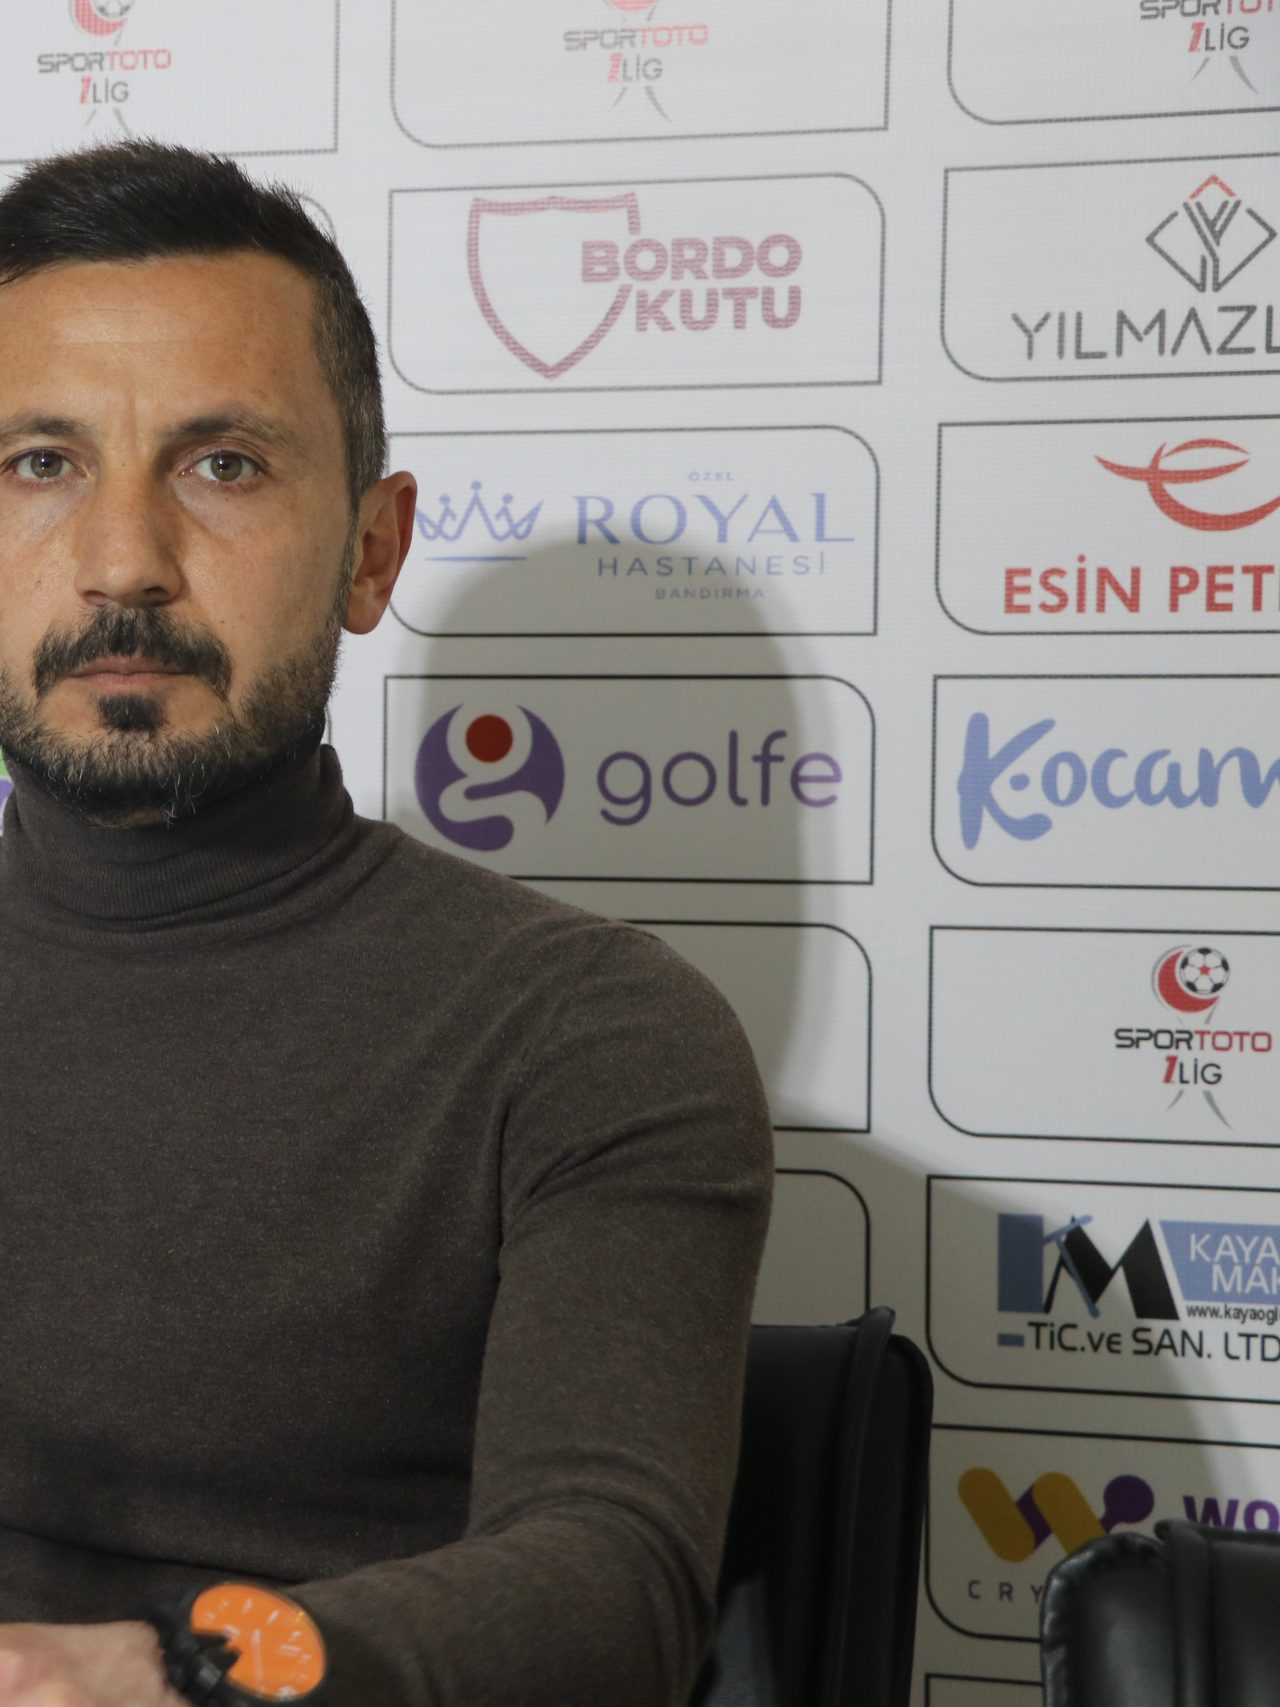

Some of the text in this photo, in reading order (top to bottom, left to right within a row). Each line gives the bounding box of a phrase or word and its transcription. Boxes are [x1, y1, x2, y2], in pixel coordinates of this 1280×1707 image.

[563, 23, 709, 51] SPORTOTO
[37, 48, 173, 74] SPORTOTO
[581, 234, 802, 283] BORDO
[635, 286, 802, 332] KUTU
[573, 492, 856, 545] ROYAL
[598, 551, 825, 577] HASTANESİ
[655, 586, 766, 600] BANDIRMA
[1004, 554, 1280, 614] ESİN PET
[597, 730, 843, 826] golfe
[1115, 1028, 1272, 1052] SPORTOTO
[1189, 1232, 1280, 1265] KAYA
[1186, 1303, 1280, 1326] www.kayaogl
[1132, 1327, 1211, 1359] SAN.
